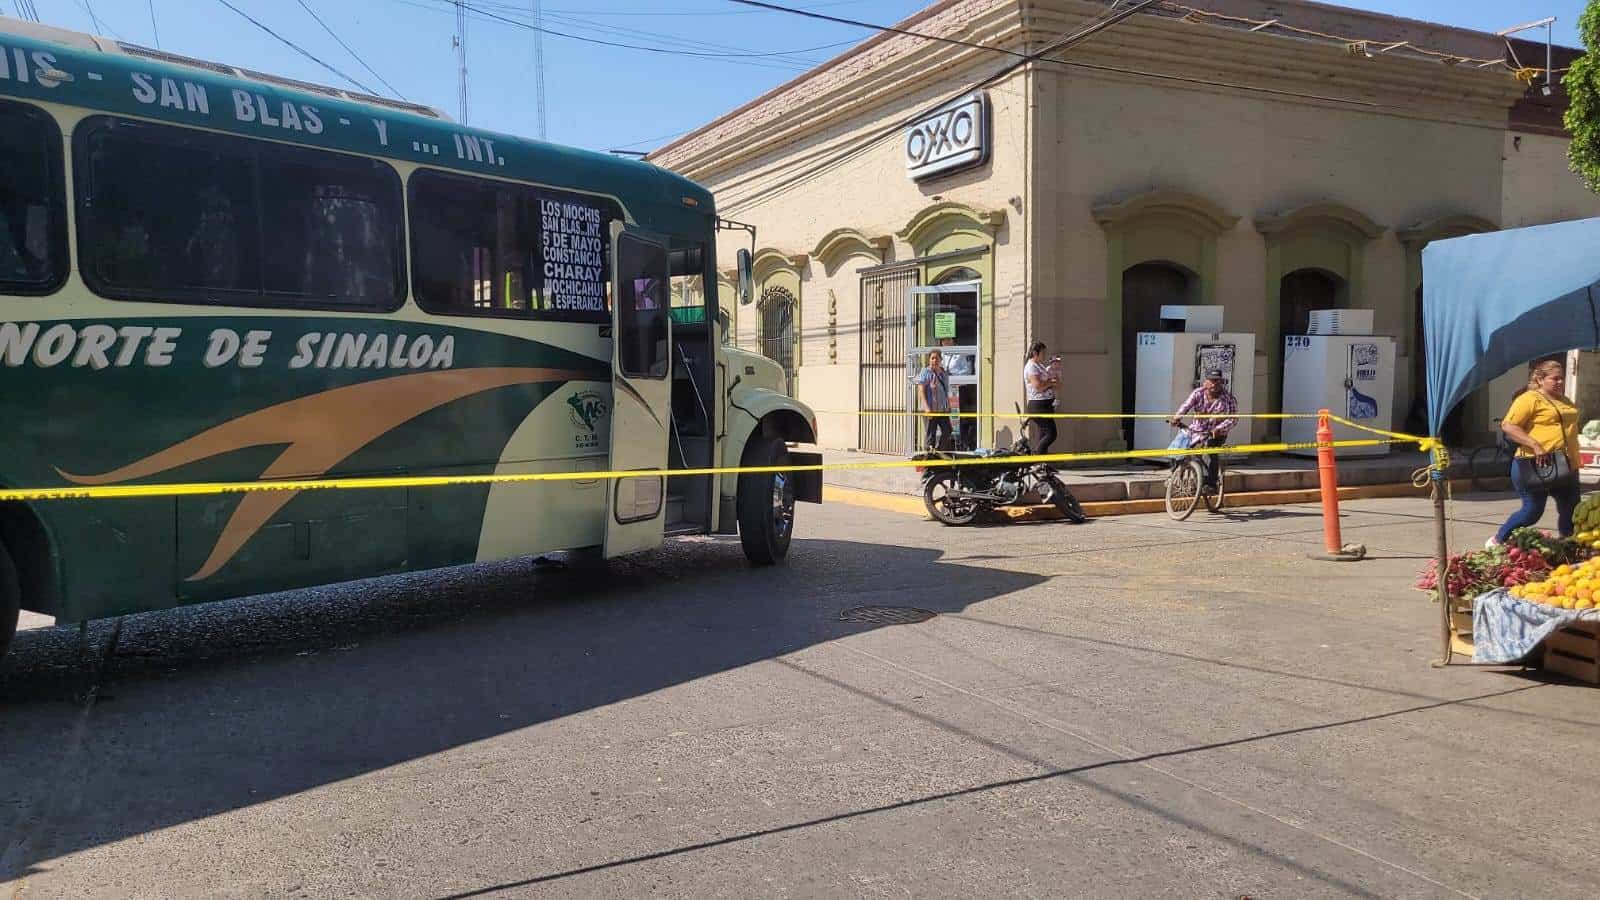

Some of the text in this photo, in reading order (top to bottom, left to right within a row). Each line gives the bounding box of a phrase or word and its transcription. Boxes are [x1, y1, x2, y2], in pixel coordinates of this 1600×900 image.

[130, 71, 210, 115] SAN
[232, 88, 324, 135] BLAS
[373, 118, 388, 145] Y
[454, 133, 505, 166] INT.
[907, 111, 973, 164] OXXO
[541, 199, 600, 223] LOS MOCHIS
[542, 216, 559, 232] SAN
[543, 231, 602, 252] 5 DE MAYO
[543, 246, 602, 267] CONSTANCIA
[544, 262, 602, 281] CHARAY
[543, 279, 604, 297] MOCHICAHUI
[556, 295, 604, 311] ESPERANZA
[0, 322, 455, 370] NORTE DE SINALOA
